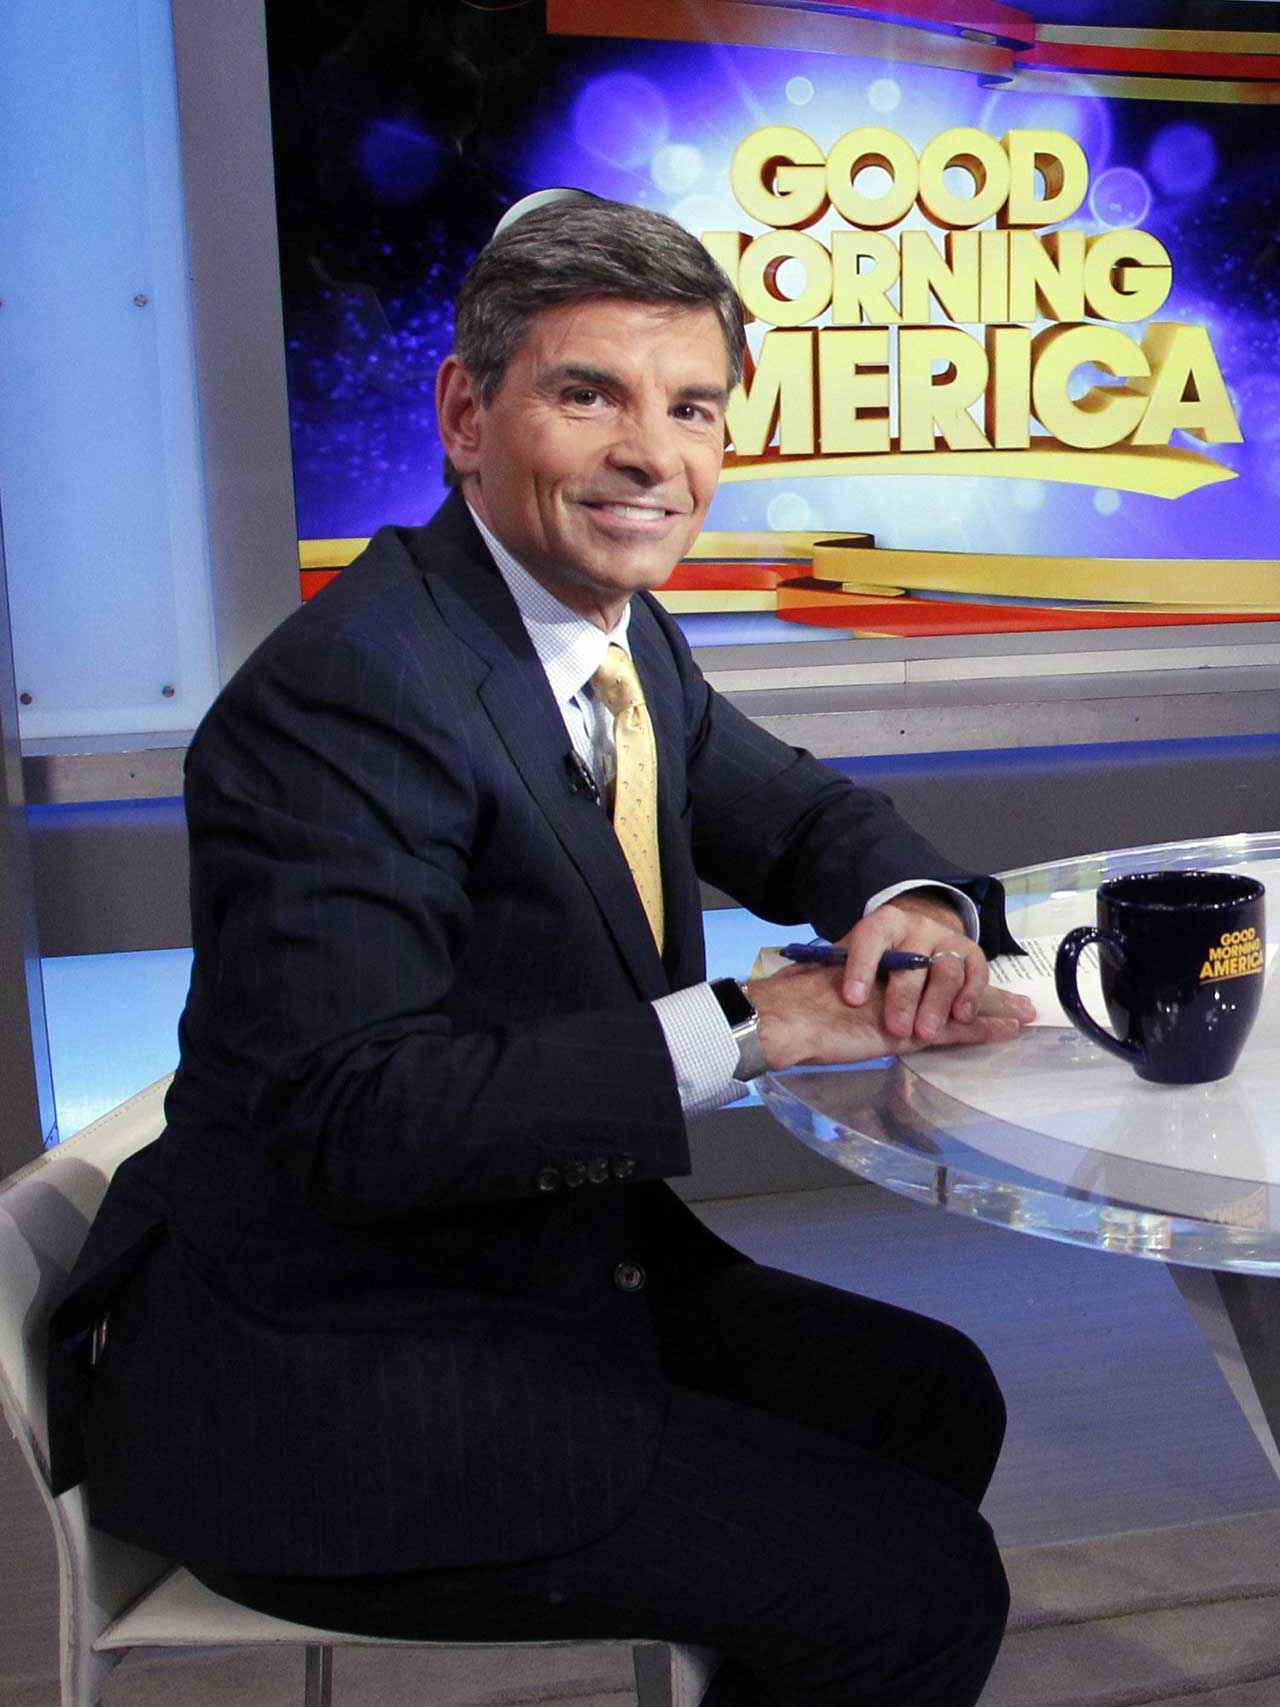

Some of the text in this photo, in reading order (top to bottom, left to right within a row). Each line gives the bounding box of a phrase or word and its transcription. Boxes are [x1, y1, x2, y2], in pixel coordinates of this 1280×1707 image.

[730, 125, 1089, 229] GOOD
[699, 228, 1173, 325] ORNING
[723, 322, 1243, 457] MERICA
[1200, 950, 1263, 978] AMERICA
[1209, 937, 1261, 961] MORNING
[1221, 927, 1255, 946] GOOD
